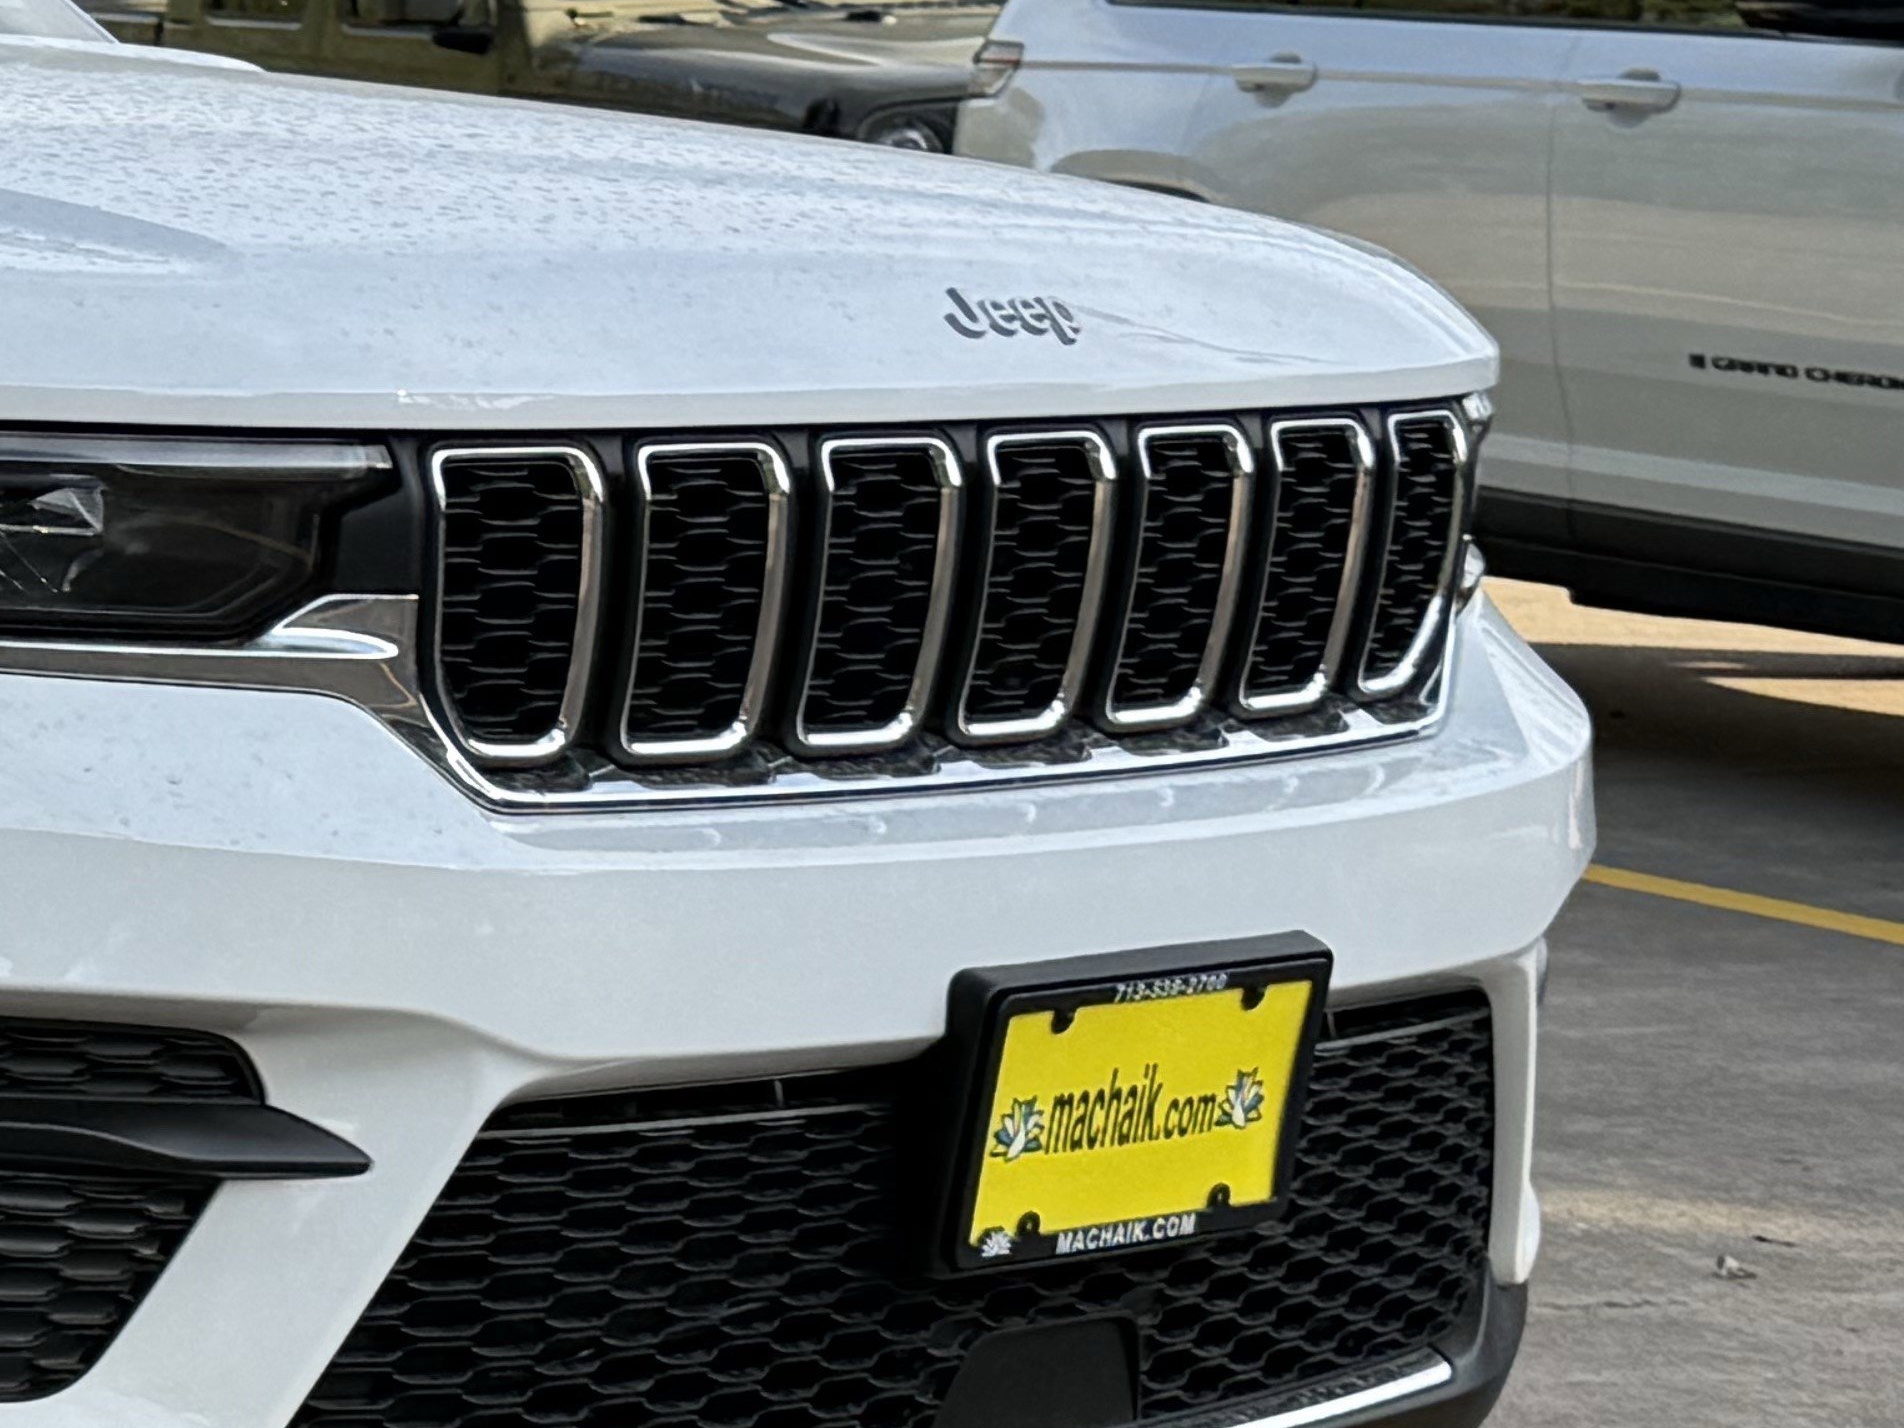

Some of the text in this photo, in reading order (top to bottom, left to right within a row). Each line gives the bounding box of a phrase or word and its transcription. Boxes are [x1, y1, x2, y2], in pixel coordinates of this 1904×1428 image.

[943, 267, 1080, 345] Jeep
[1044, 1063, 1218, 1156] machaik.com
[1055, 1212, 1197, 1255] MACHAIK.COM
